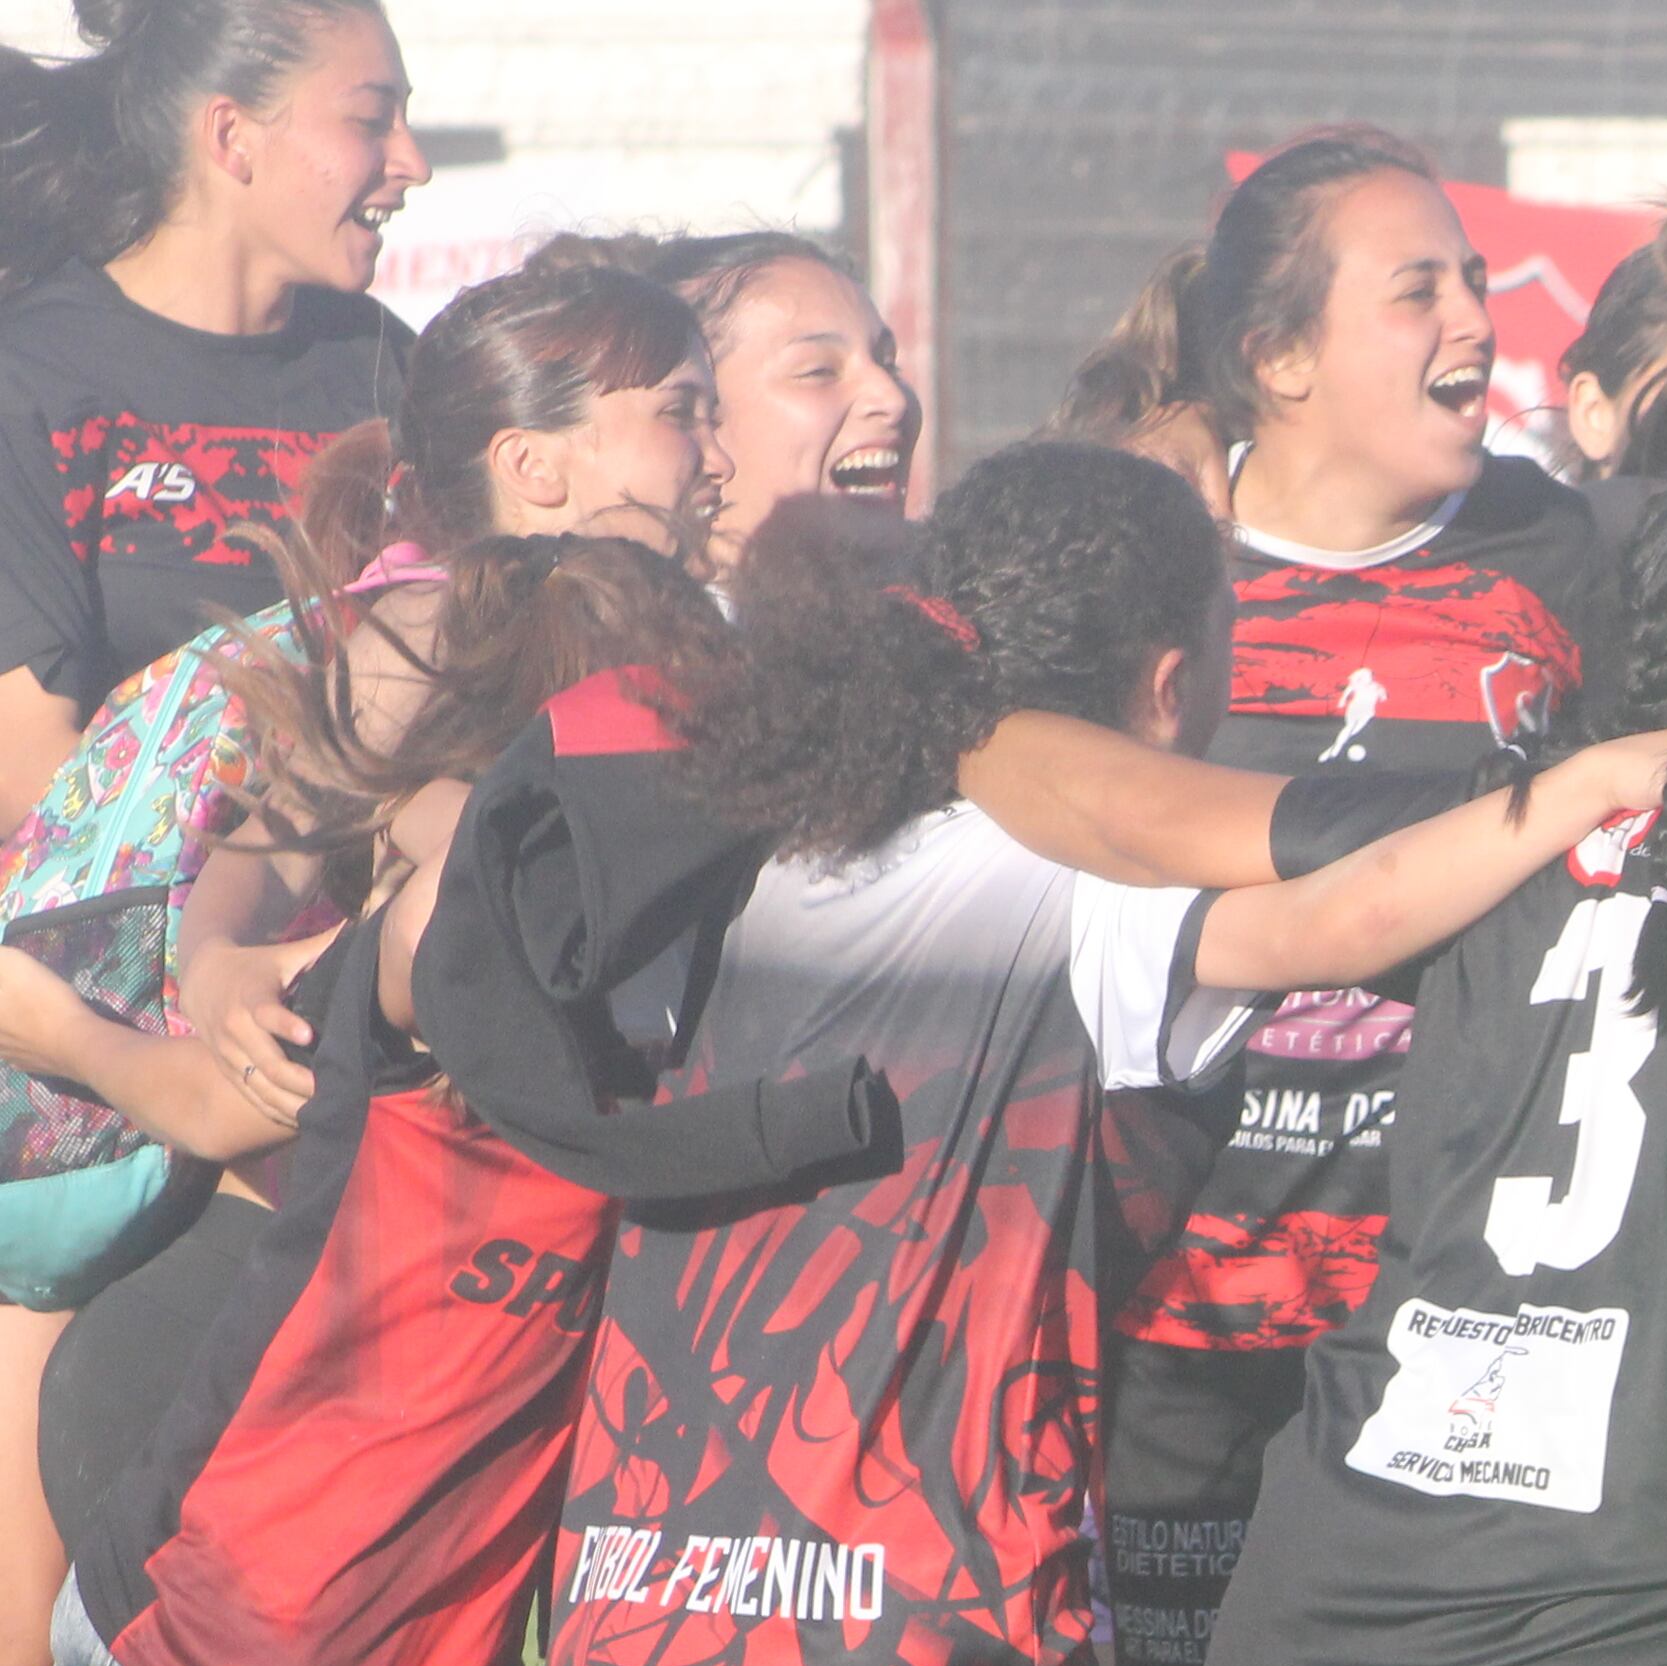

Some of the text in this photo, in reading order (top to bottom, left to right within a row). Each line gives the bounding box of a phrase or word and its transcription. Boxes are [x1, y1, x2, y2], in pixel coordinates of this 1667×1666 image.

[1484, 893, 1658, 1277] 3
[1459, 1460, 1551, 1492] MECANICO
[659, 1534, 886, 1621] FEMENINO
